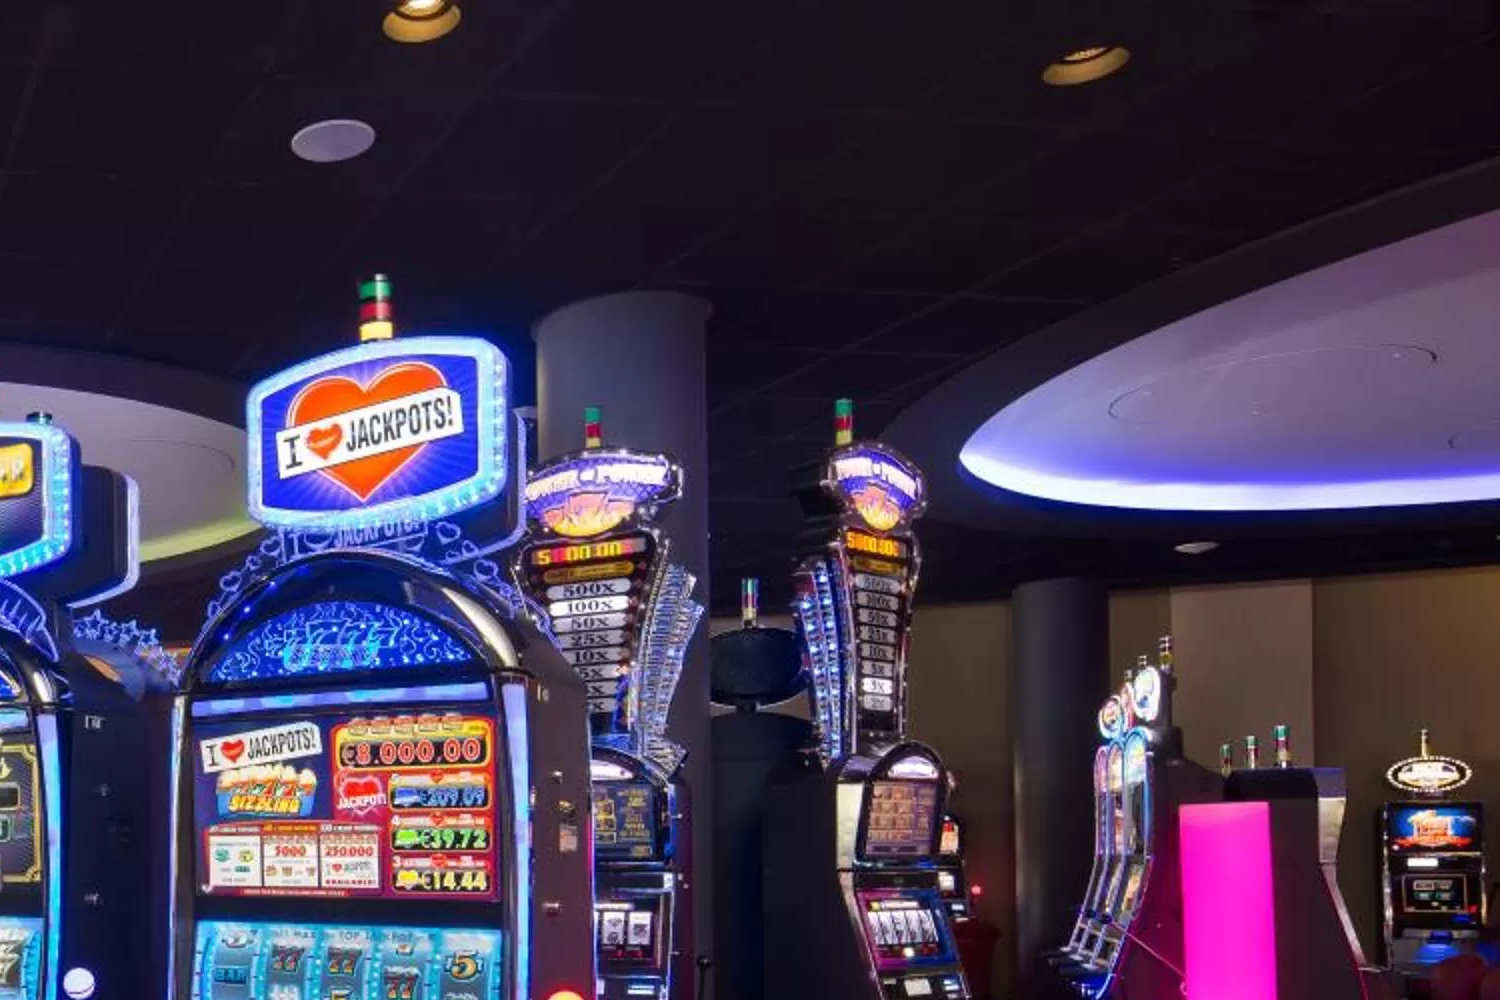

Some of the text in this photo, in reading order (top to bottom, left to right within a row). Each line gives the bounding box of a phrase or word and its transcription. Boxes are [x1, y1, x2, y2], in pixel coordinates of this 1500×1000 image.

[283, 395, 454, 470] I JACKPOTS!
[246, 727, 318, 760] JACKPOTS!
